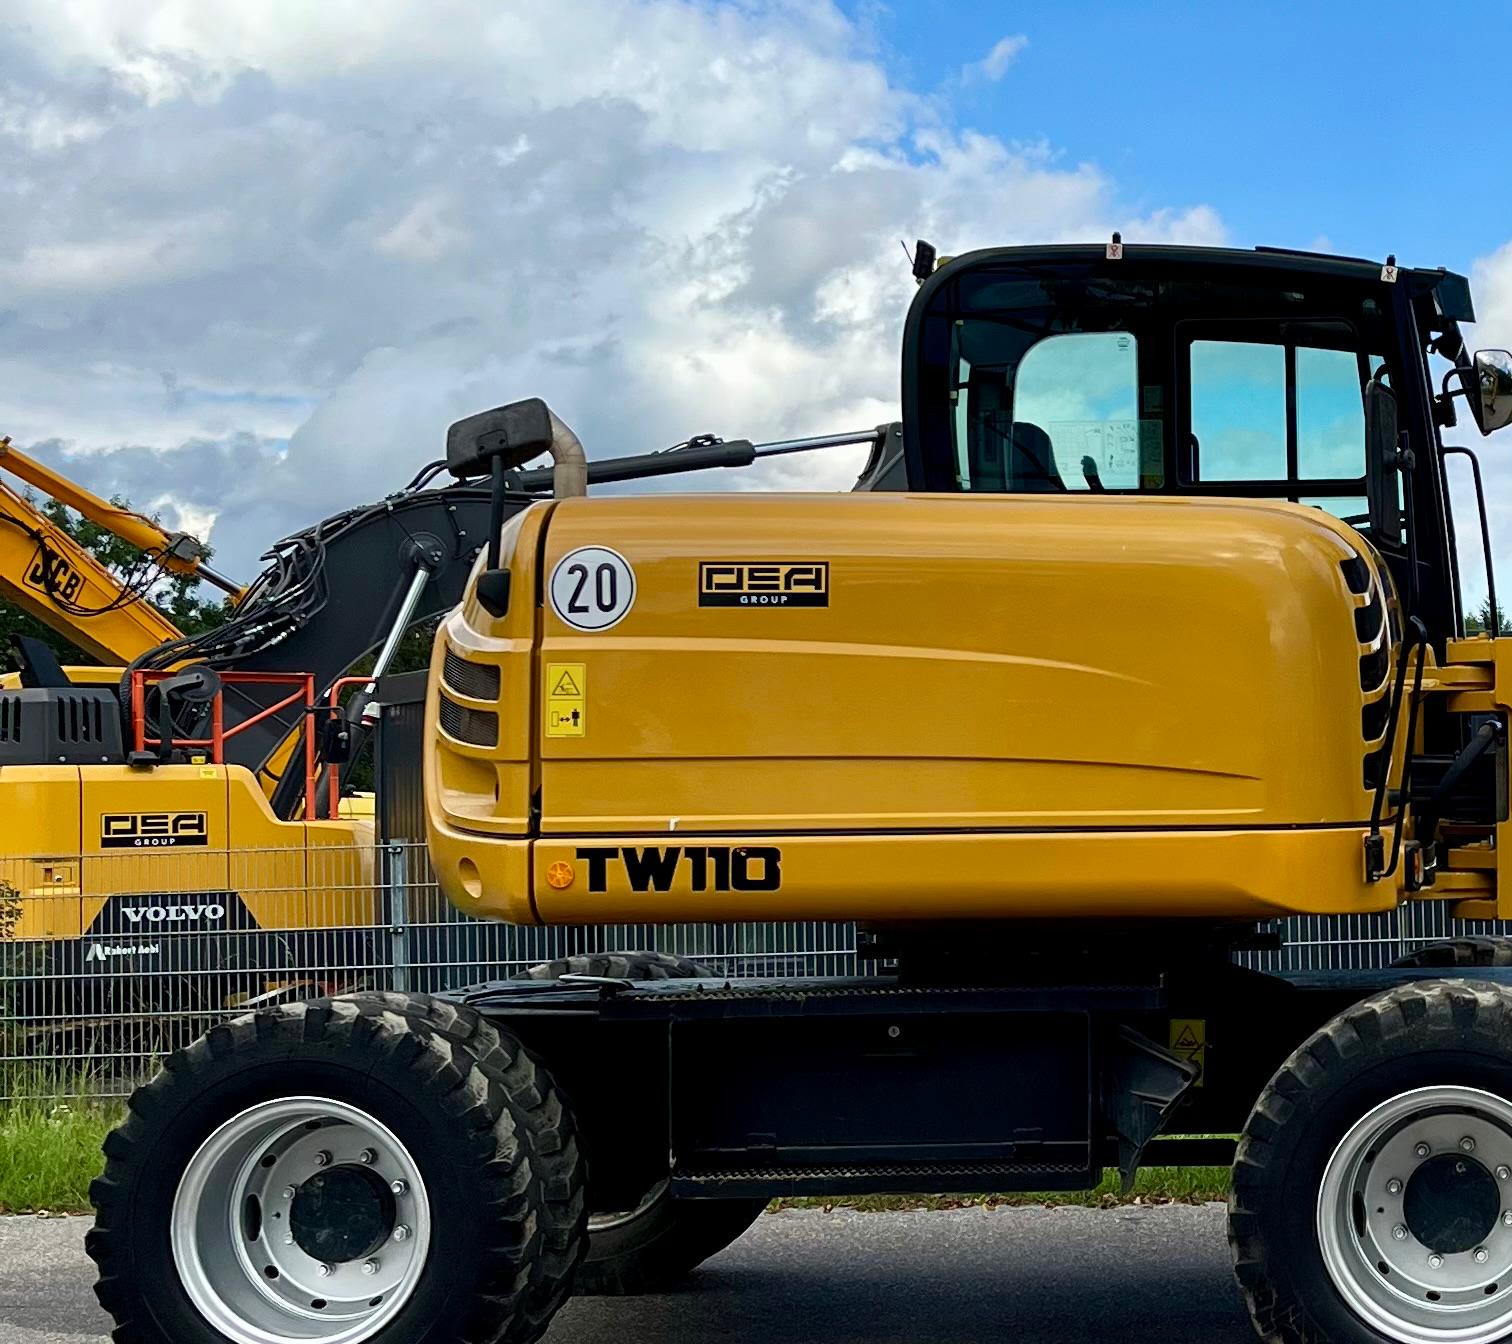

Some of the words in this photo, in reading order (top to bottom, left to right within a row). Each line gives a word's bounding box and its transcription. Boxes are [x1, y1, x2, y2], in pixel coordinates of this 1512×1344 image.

[567, 562, 617, 614] 20
[739, 595, 788, 604] GROUP
[134, 838, 176, 846] GROUP
[576, 847, 781, 892] TW110
[121, 904, 225, 922] VOLVO
